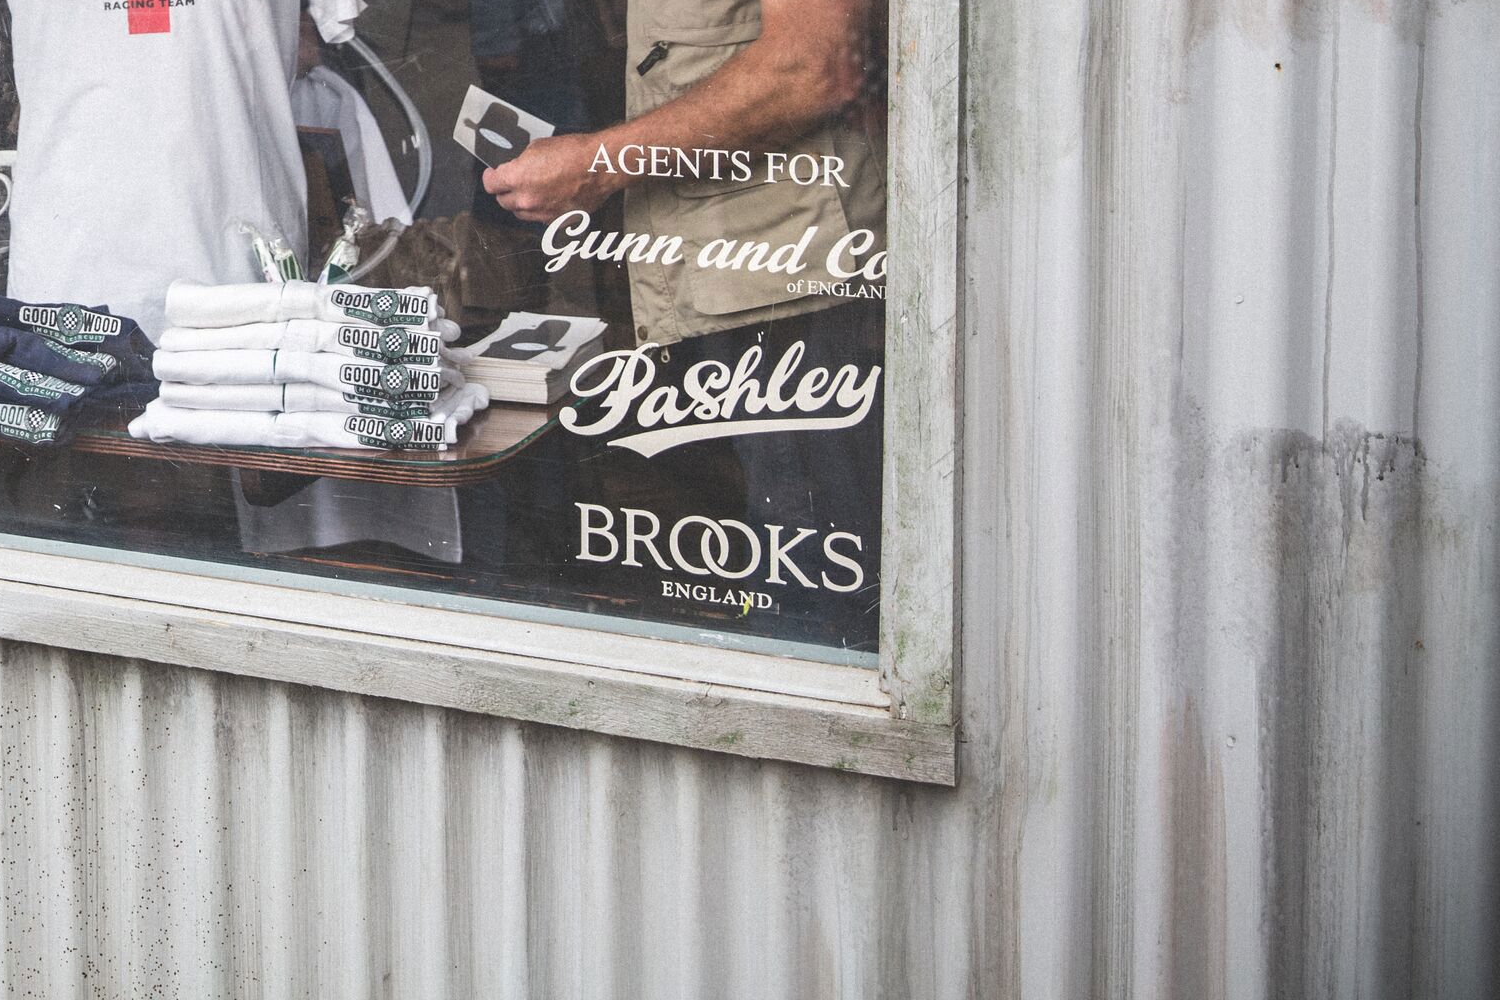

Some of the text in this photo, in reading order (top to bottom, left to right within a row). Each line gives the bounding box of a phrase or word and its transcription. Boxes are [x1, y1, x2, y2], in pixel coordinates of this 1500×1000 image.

[104, 0, 155, 11] RACING
[588, 143, 850, 188] AGENTS FOR
[541, 210, 685, 274] Gunn
[697, 226, 819, 275] and
[787, 280, 887, 300] of ENGLAN
[336, 292, 371, 309] GOOD
[22, 307, 119, 333] GOOD WOOD
[383, 316, 421, 324] CIRCUIT
[36, 326, 66, 341] MOTOR
[343, 328, 380, 349] GOOD
[44, 375, 83, 394] WOOD
[344, 366, 381, 386] GOOD
[25, 386, 60, 398] CIRCUIT
[559, 341, 882, 458] Pashley
[3, 426, 30, 438] MOTOR
[348, 418, 385, 437] GOOD
[575, 502, 864, 593] BROOKS
[661, 580, 774, 610] ENGLAND
